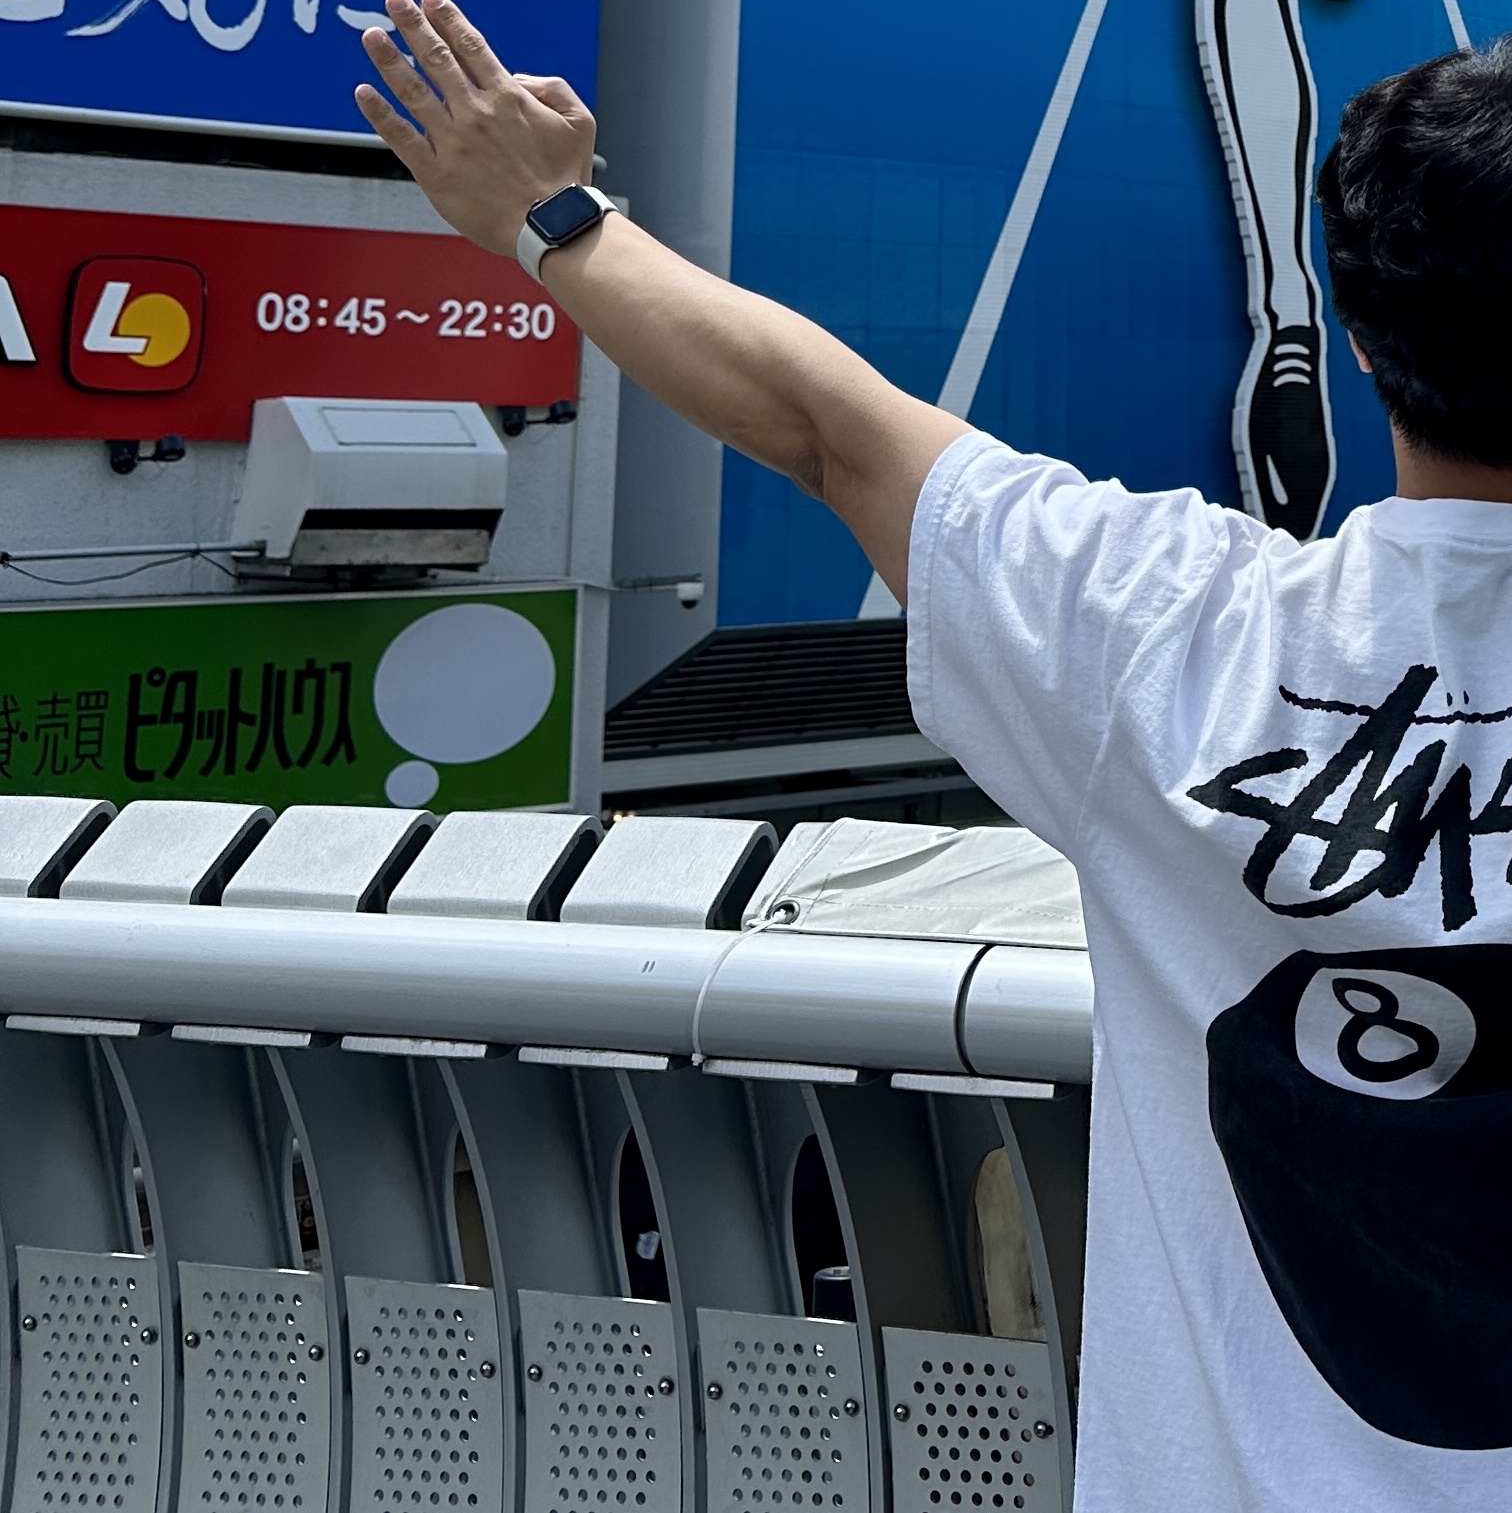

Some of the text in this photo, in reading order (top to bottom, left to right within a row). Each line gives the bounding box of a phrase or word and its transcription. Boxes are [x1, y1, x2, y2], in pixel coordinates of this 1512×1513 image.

[123, 657, 358, 785] ピタットハウス
[1331, 975, 1441, 1084] 8
